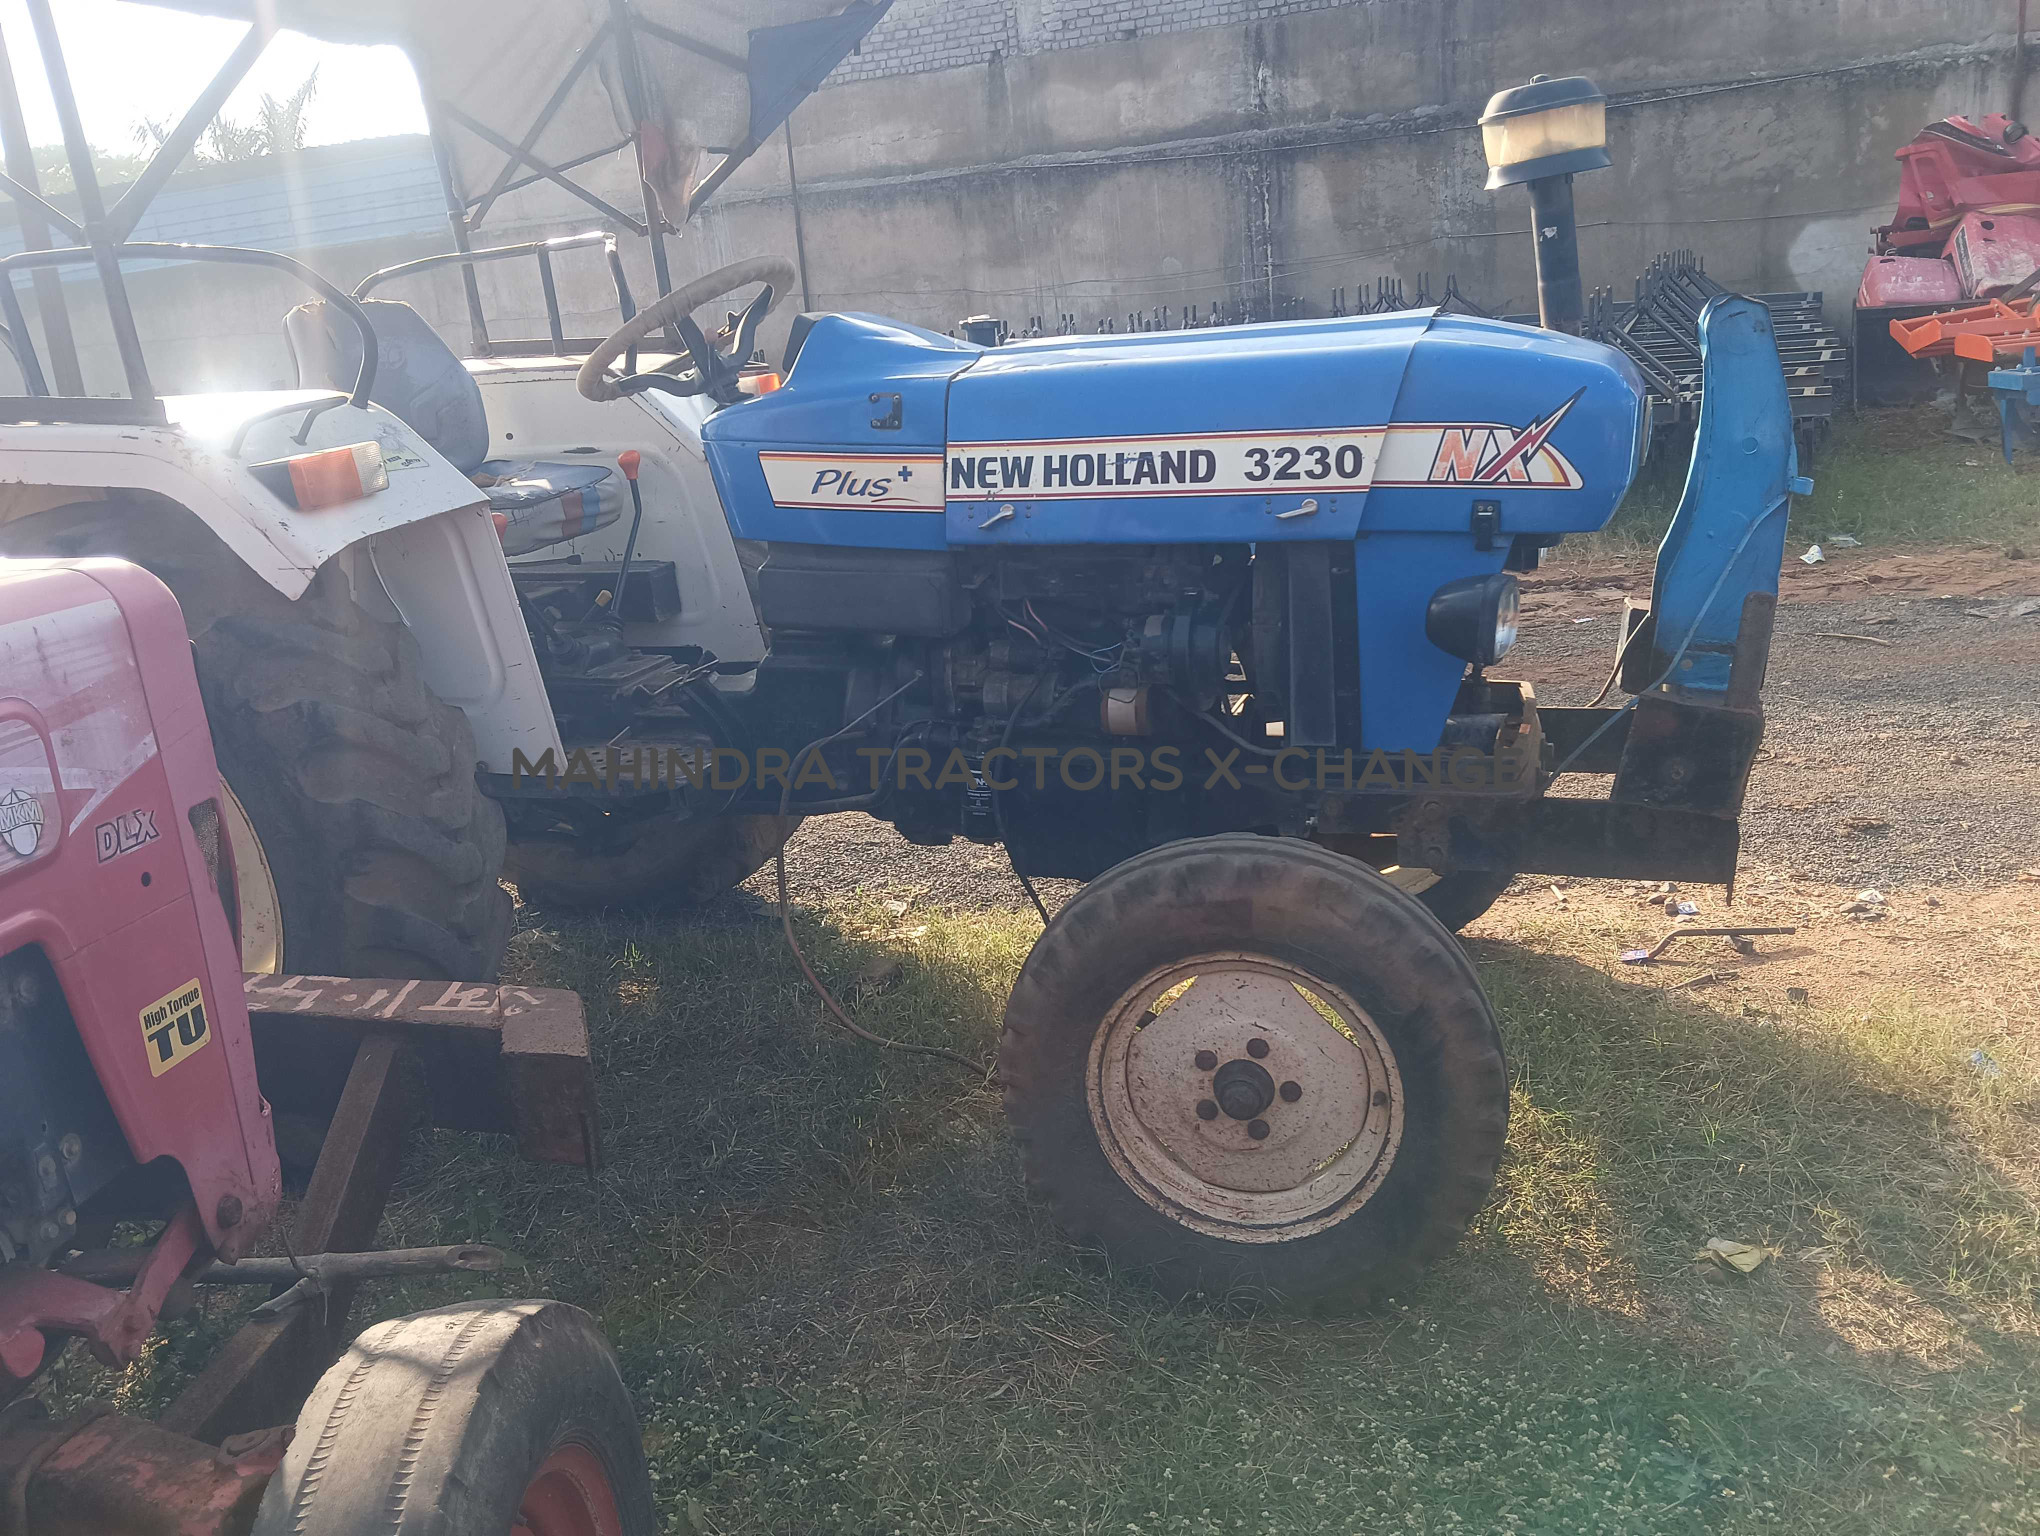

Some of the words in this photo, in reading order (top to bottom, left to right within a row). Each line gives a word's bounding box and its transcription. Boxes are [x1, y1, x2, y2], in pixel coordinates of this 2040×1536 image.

[950, 455, 1035, 490] NEW
[1043, 449, 1217, 488] HOLLAND
[1243, 444, 1364, 482] 3230
[95, 808, 160, 864] DLX
[143, 1005, 168, 1031] High
[166, 987, 200, 1016] Torque
[147, 1003, 207, 1063] TU
